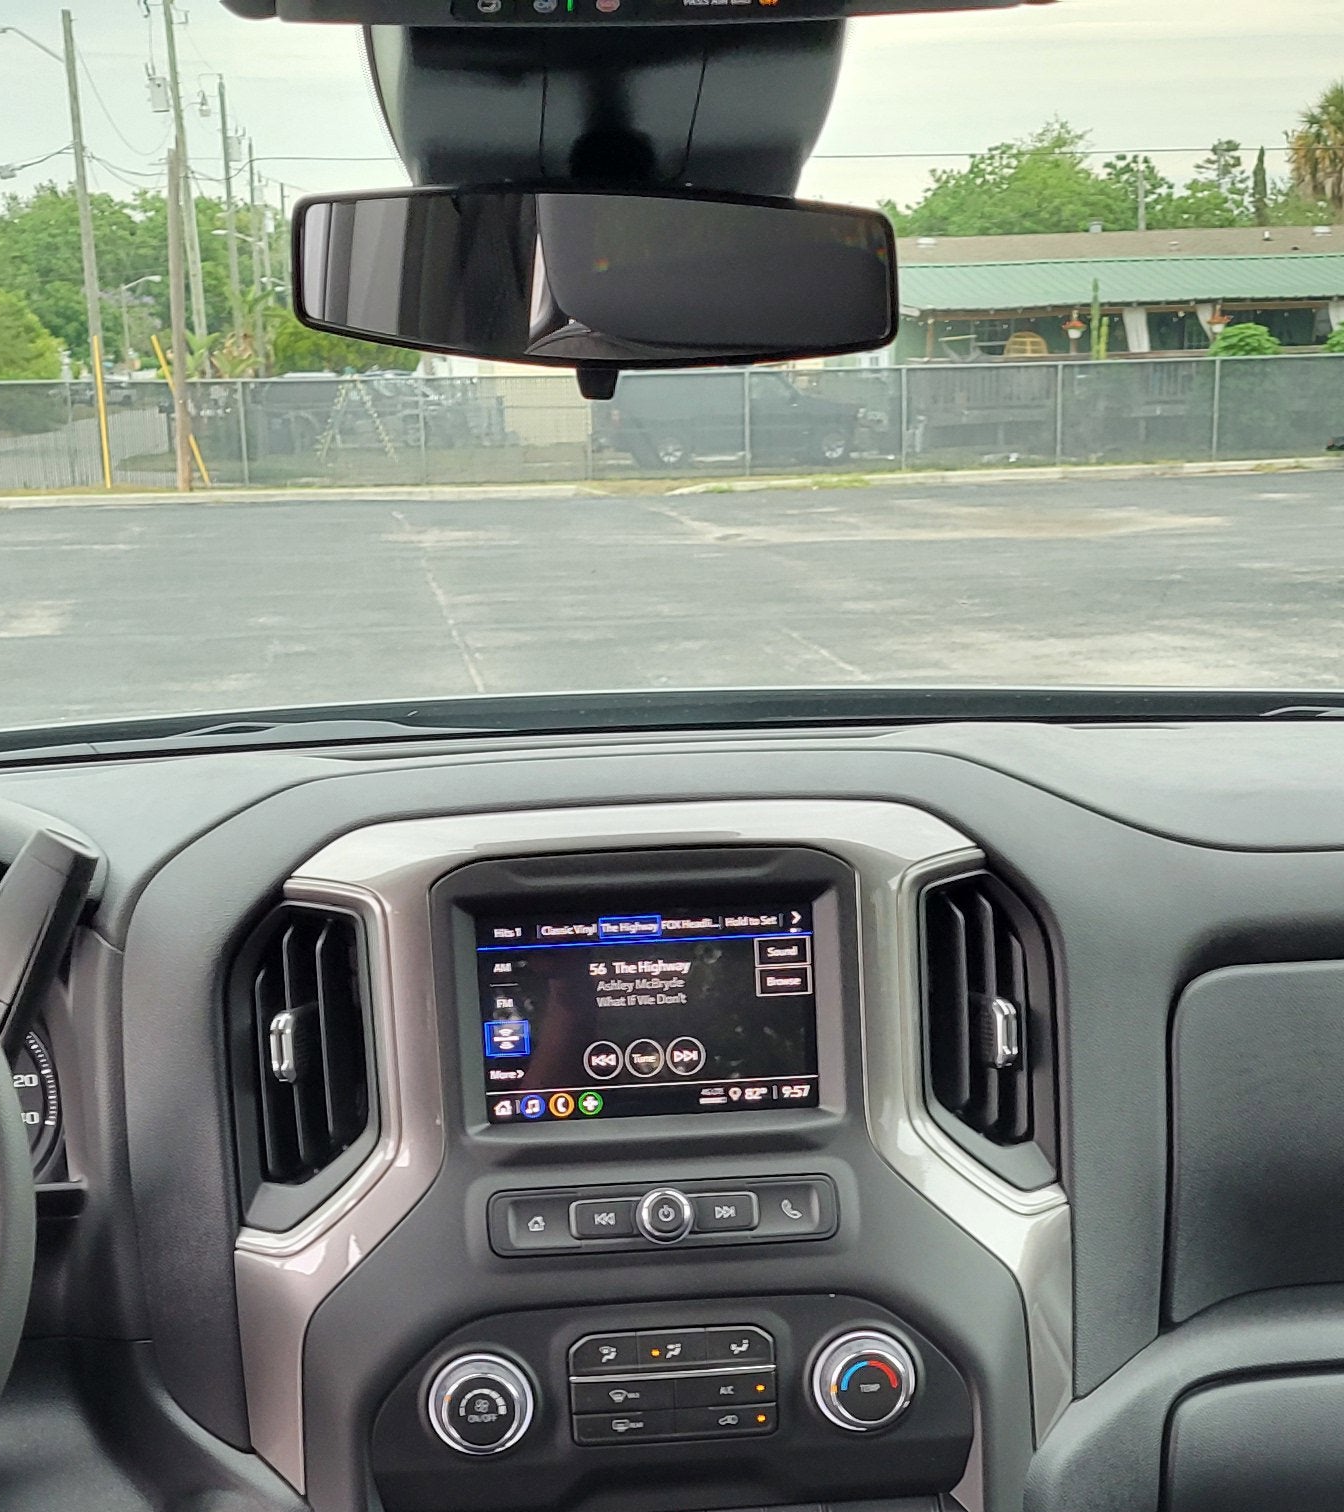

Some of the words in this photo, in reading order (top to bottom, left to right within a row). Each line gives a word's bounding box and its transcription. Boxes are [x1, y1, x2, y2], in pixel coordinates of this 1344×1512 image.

[767, 946, 798, 957] Sound
[493, 963, 512, 973] AM
[589, 963, 608, 976] 56
[612, 962, 637, 974] The
[638, 960, 691, 976] Highway
[597, 980, 635, 993] Ashley
[636, 977, 686, 991] McBryde
[766, 976, 802, 987] Browse
[496, 998, 514, 1008] FM
[596, 996, 627, 1007] What
[637, 994, 656, 1006] We
[781, 1085, 811, 1098] 9:57
